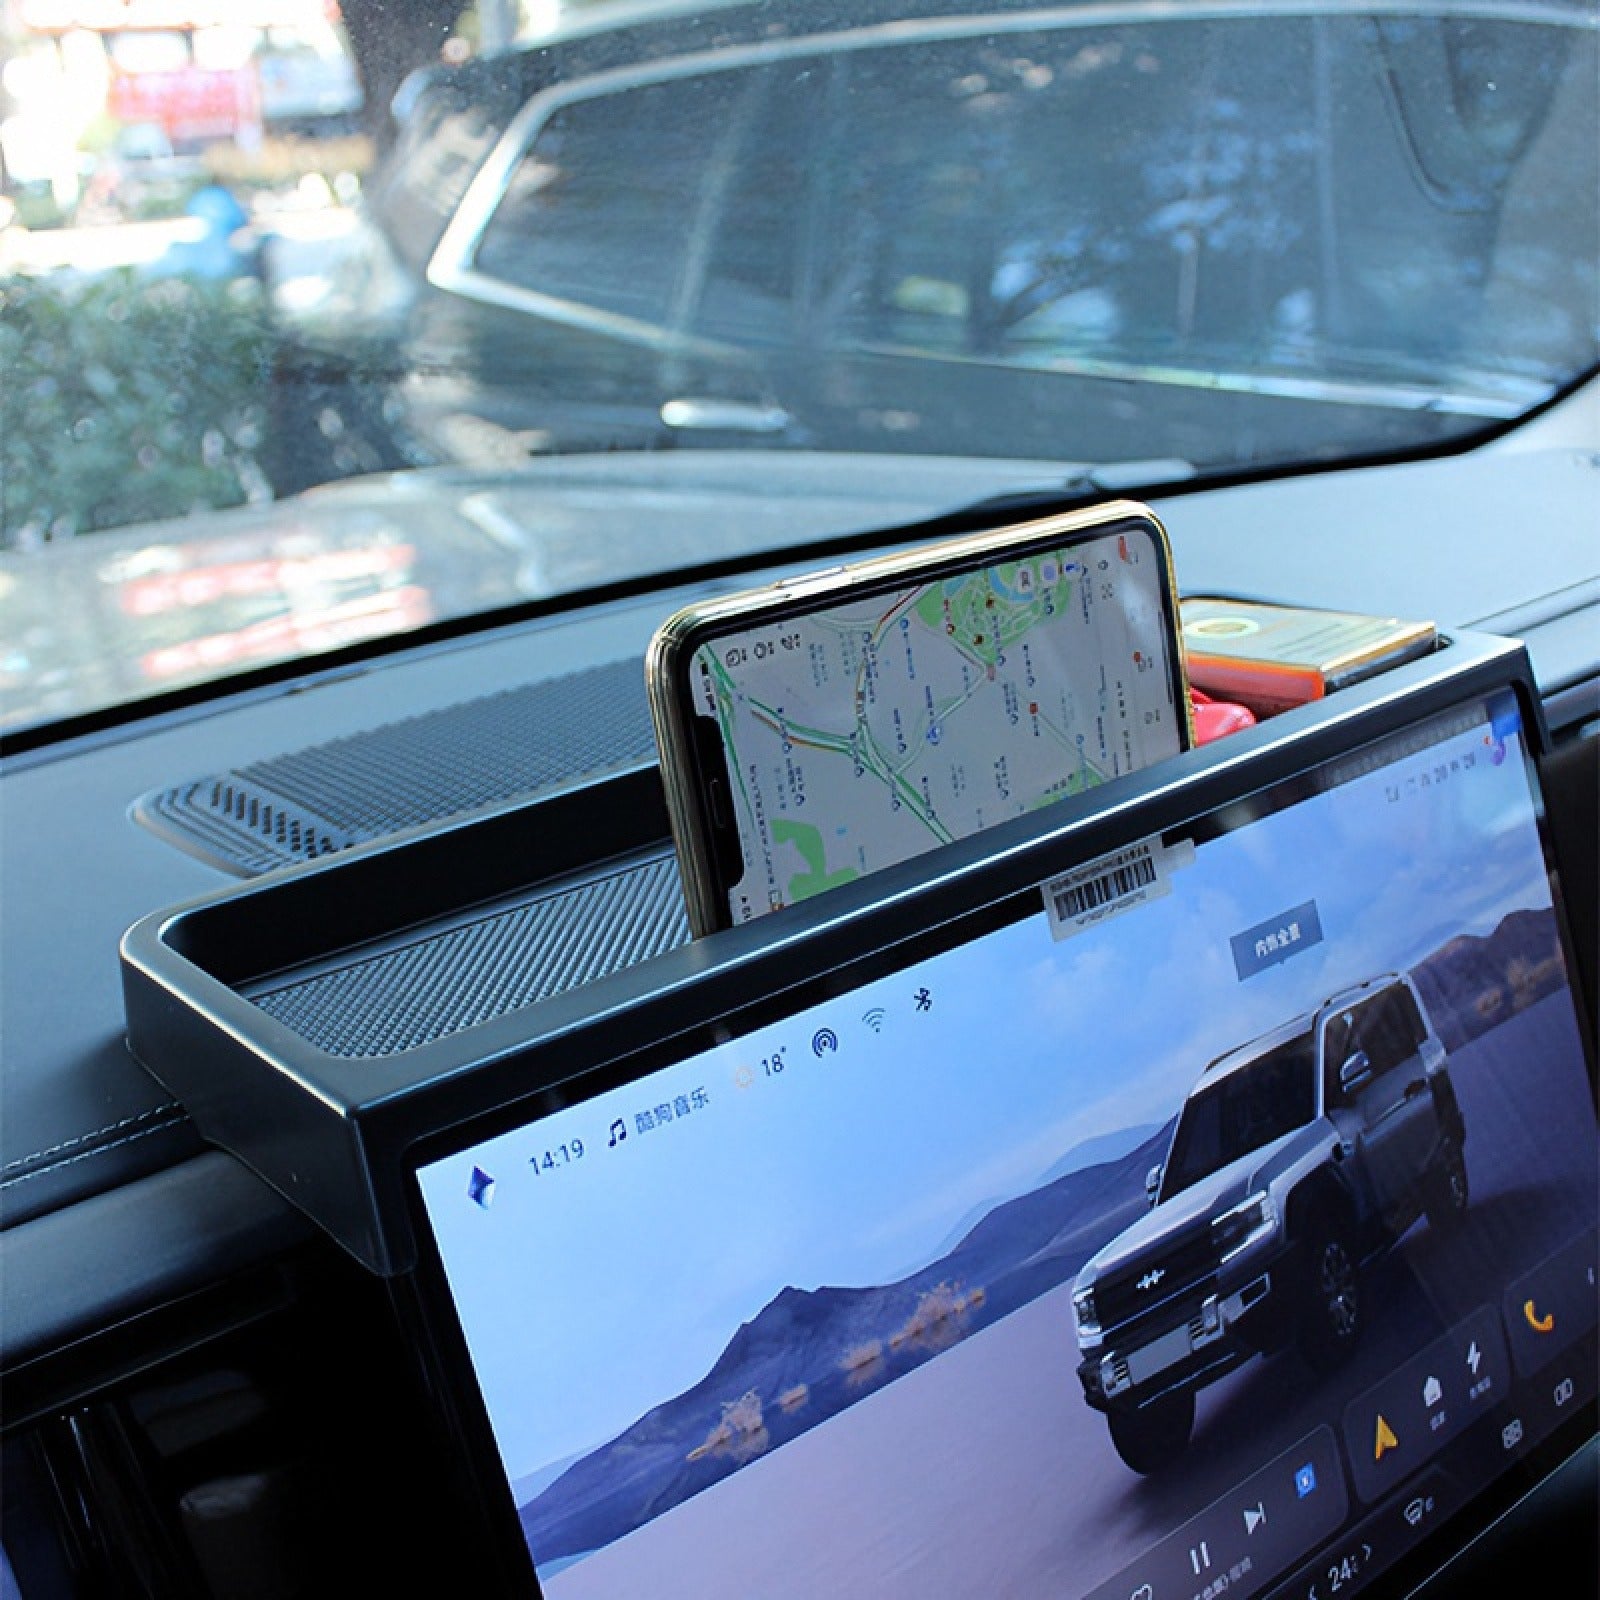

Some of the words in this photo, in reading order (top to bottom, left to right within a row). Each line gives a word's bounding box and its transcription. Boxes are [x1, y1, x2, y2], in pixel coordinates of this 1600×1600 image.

[529, 1139, 584, 1176] 14:19
[635, 1086, 709, 1134] 酷狗音乐
